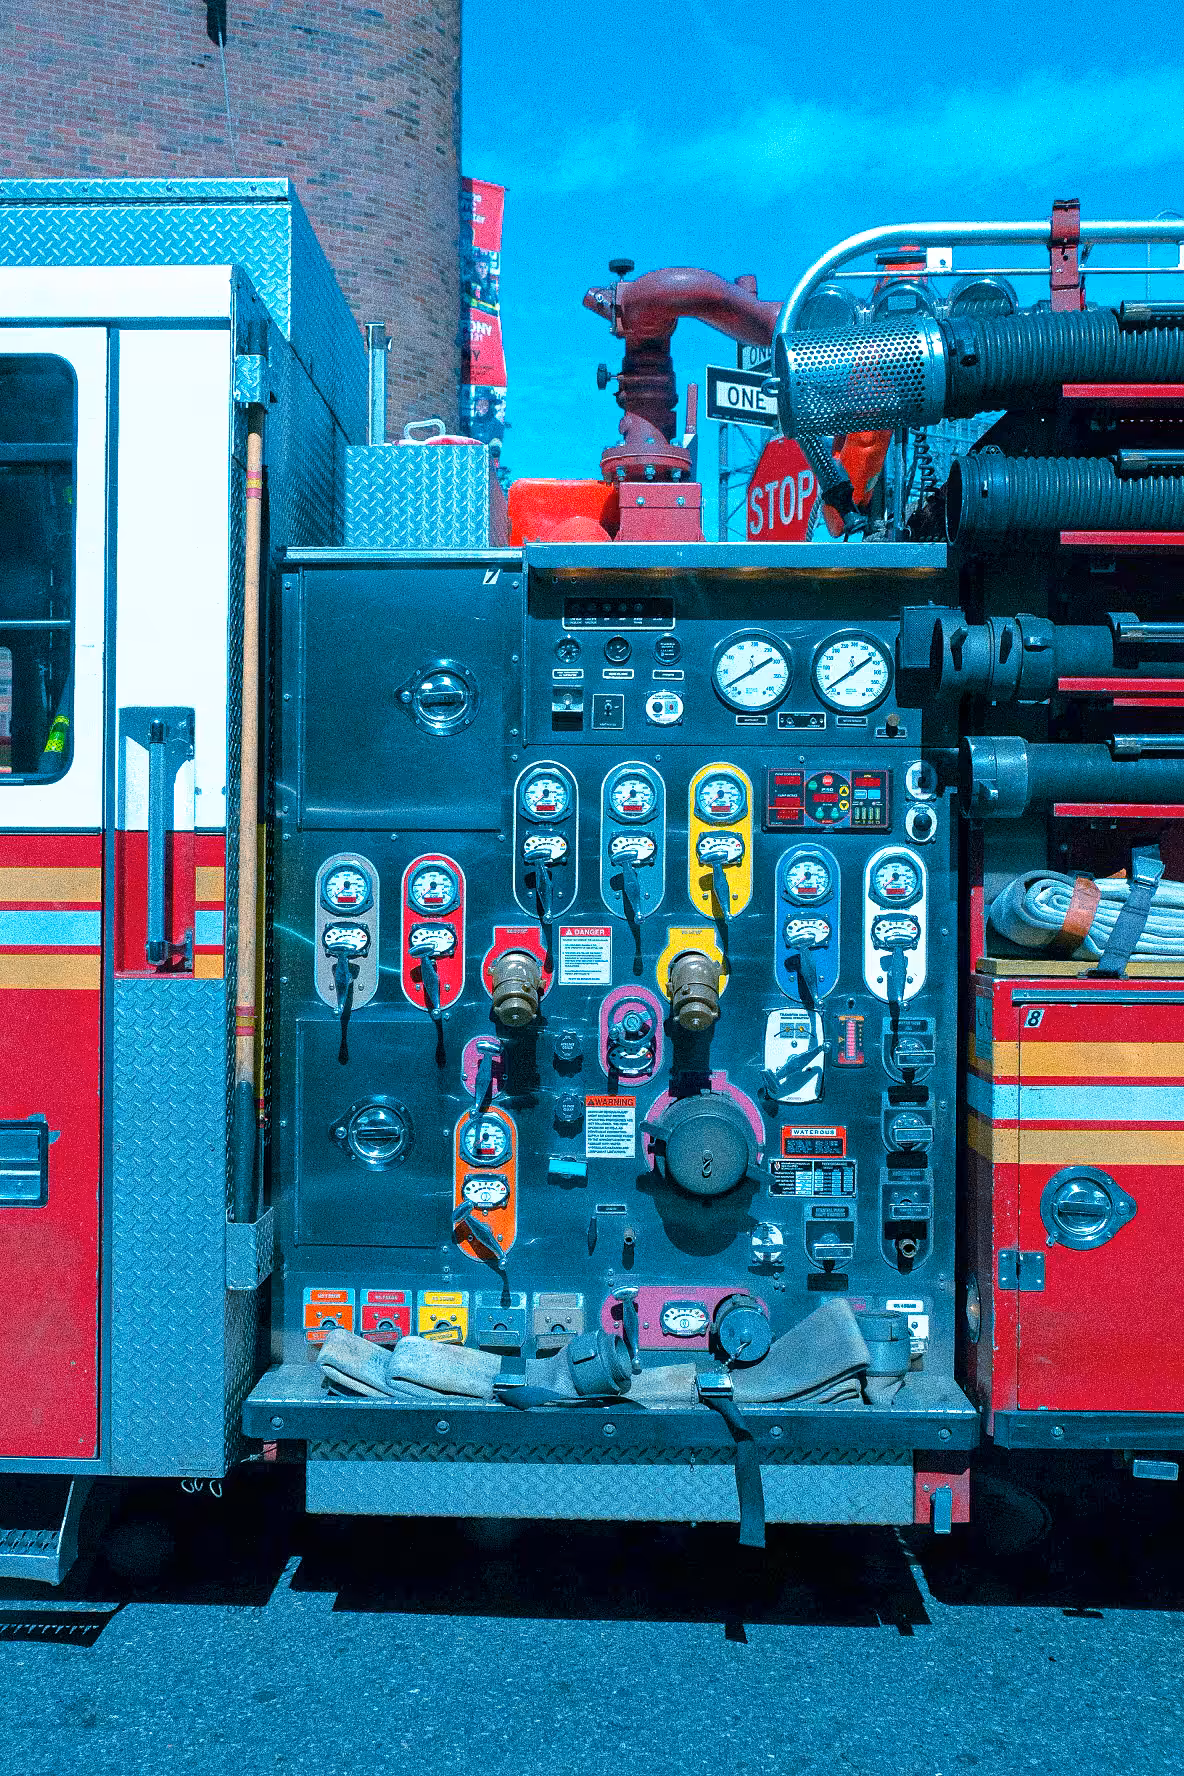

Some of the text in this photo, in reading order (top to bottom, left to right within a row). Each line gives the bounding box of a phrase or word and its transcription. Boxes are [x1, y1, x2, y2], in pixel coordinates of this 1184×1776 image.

[750, 347, 771, 365] ON
[728, 386, 766, 410] ONE
[750, 470, 814, 535] STOP
[1028, 1010, 1041, 1027] 8
[595, 1098, 634, 1106] WARNING
